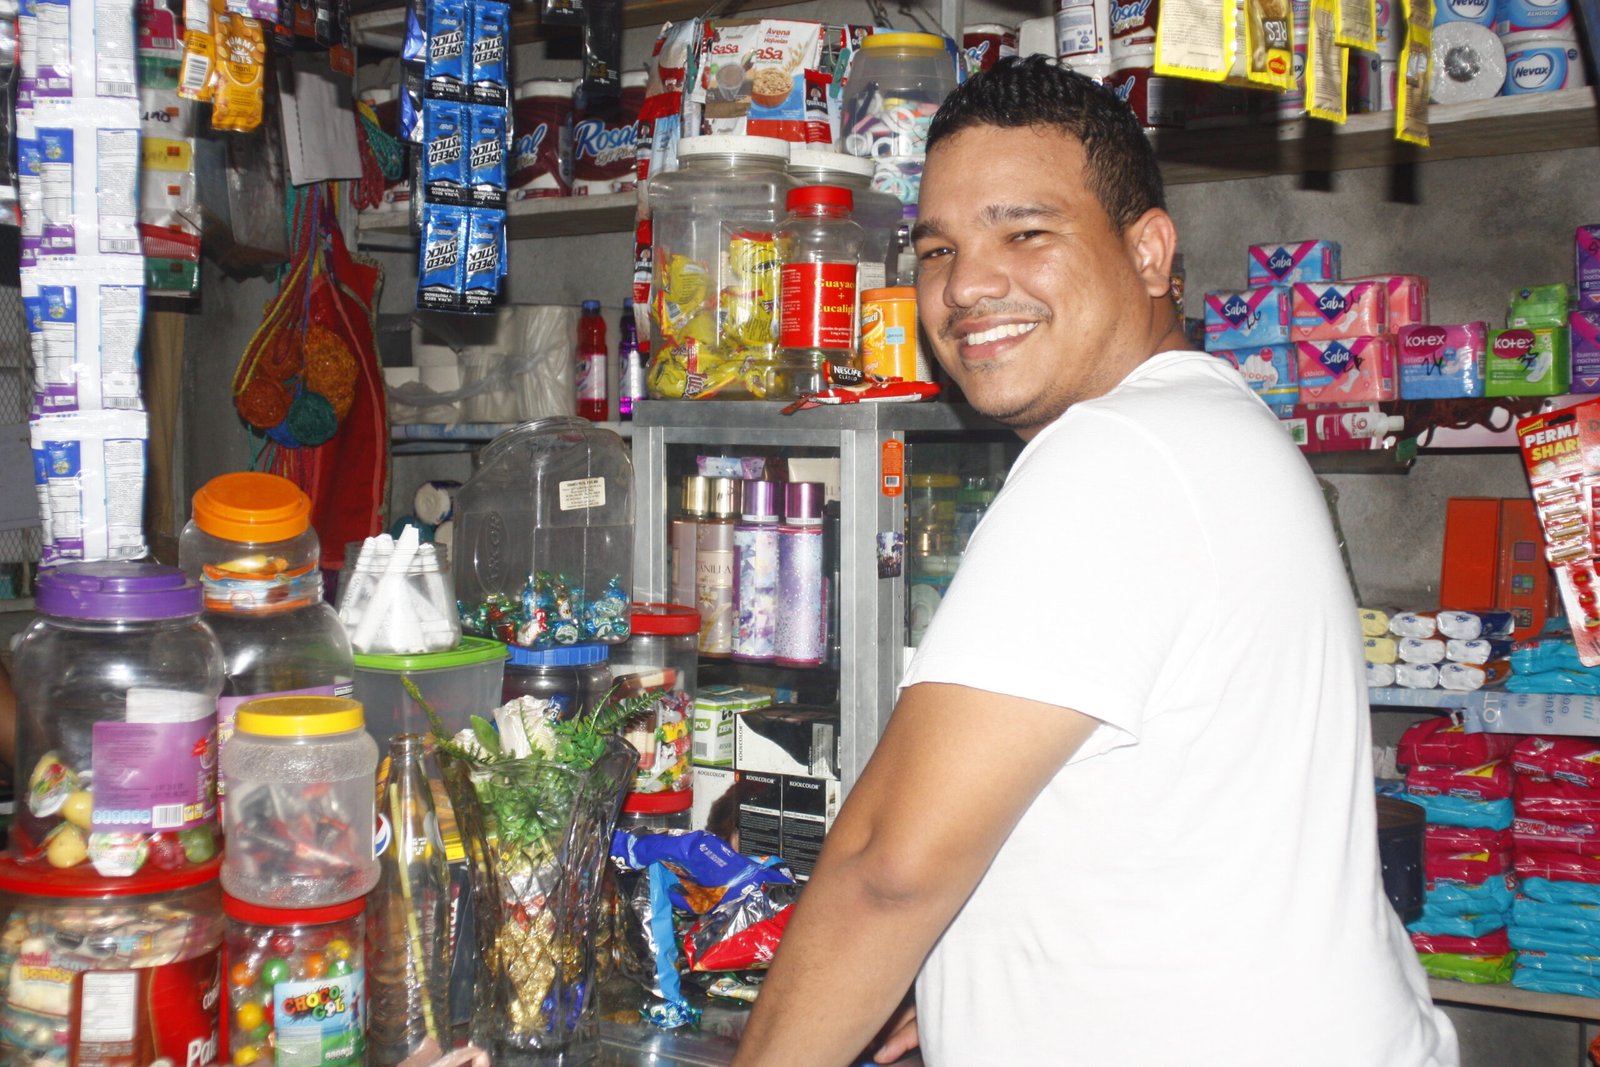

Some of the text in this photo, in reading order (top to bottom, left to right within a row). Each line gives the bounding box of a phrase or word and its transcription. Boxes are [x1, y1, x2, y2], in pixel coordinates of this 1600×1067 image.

[767, 28, 790, 36] Avena
[1266, 21, 1287, 41] RES
[431, 31, 462, 49] STICK
[473, 37, 502, 54] STICK
[431, 43, 463, 59] SPEED
[473, 48, 503, 64] SPEED
[230, 55, 253, 64] NUTS
[1515, 66, 1550, 79] Nevax
[428, 135, 458, 154] STICK
[470, 141, 500, 158] STICK
[430, 147, 460, 164] SPEED
[471, 152, 501, 168] SPEED
[426, 241, 456, 259] STICK
[468, 244, 496, 262] STICK
[426, 252, 457, 269] SPEED
[468, 256, 497, 272] SPEED
[1270, 253, 1292, 269] Saba
[1224, 300, 1247, 317] Saba
[1320, 294, 1345, 310] Saba
[1324, 349, 1350, 365] Saba
[698, 564, 731, 574] ANILLA
[694, 720, 708, 730] POL
[718, 721, 733, 733] ZEP
[746, 775, 775, 785] KOOLCOLOR
[789, 781, 819, 790] KOOLCOLOR
[282, 985, 340, 1015] CHOCO
